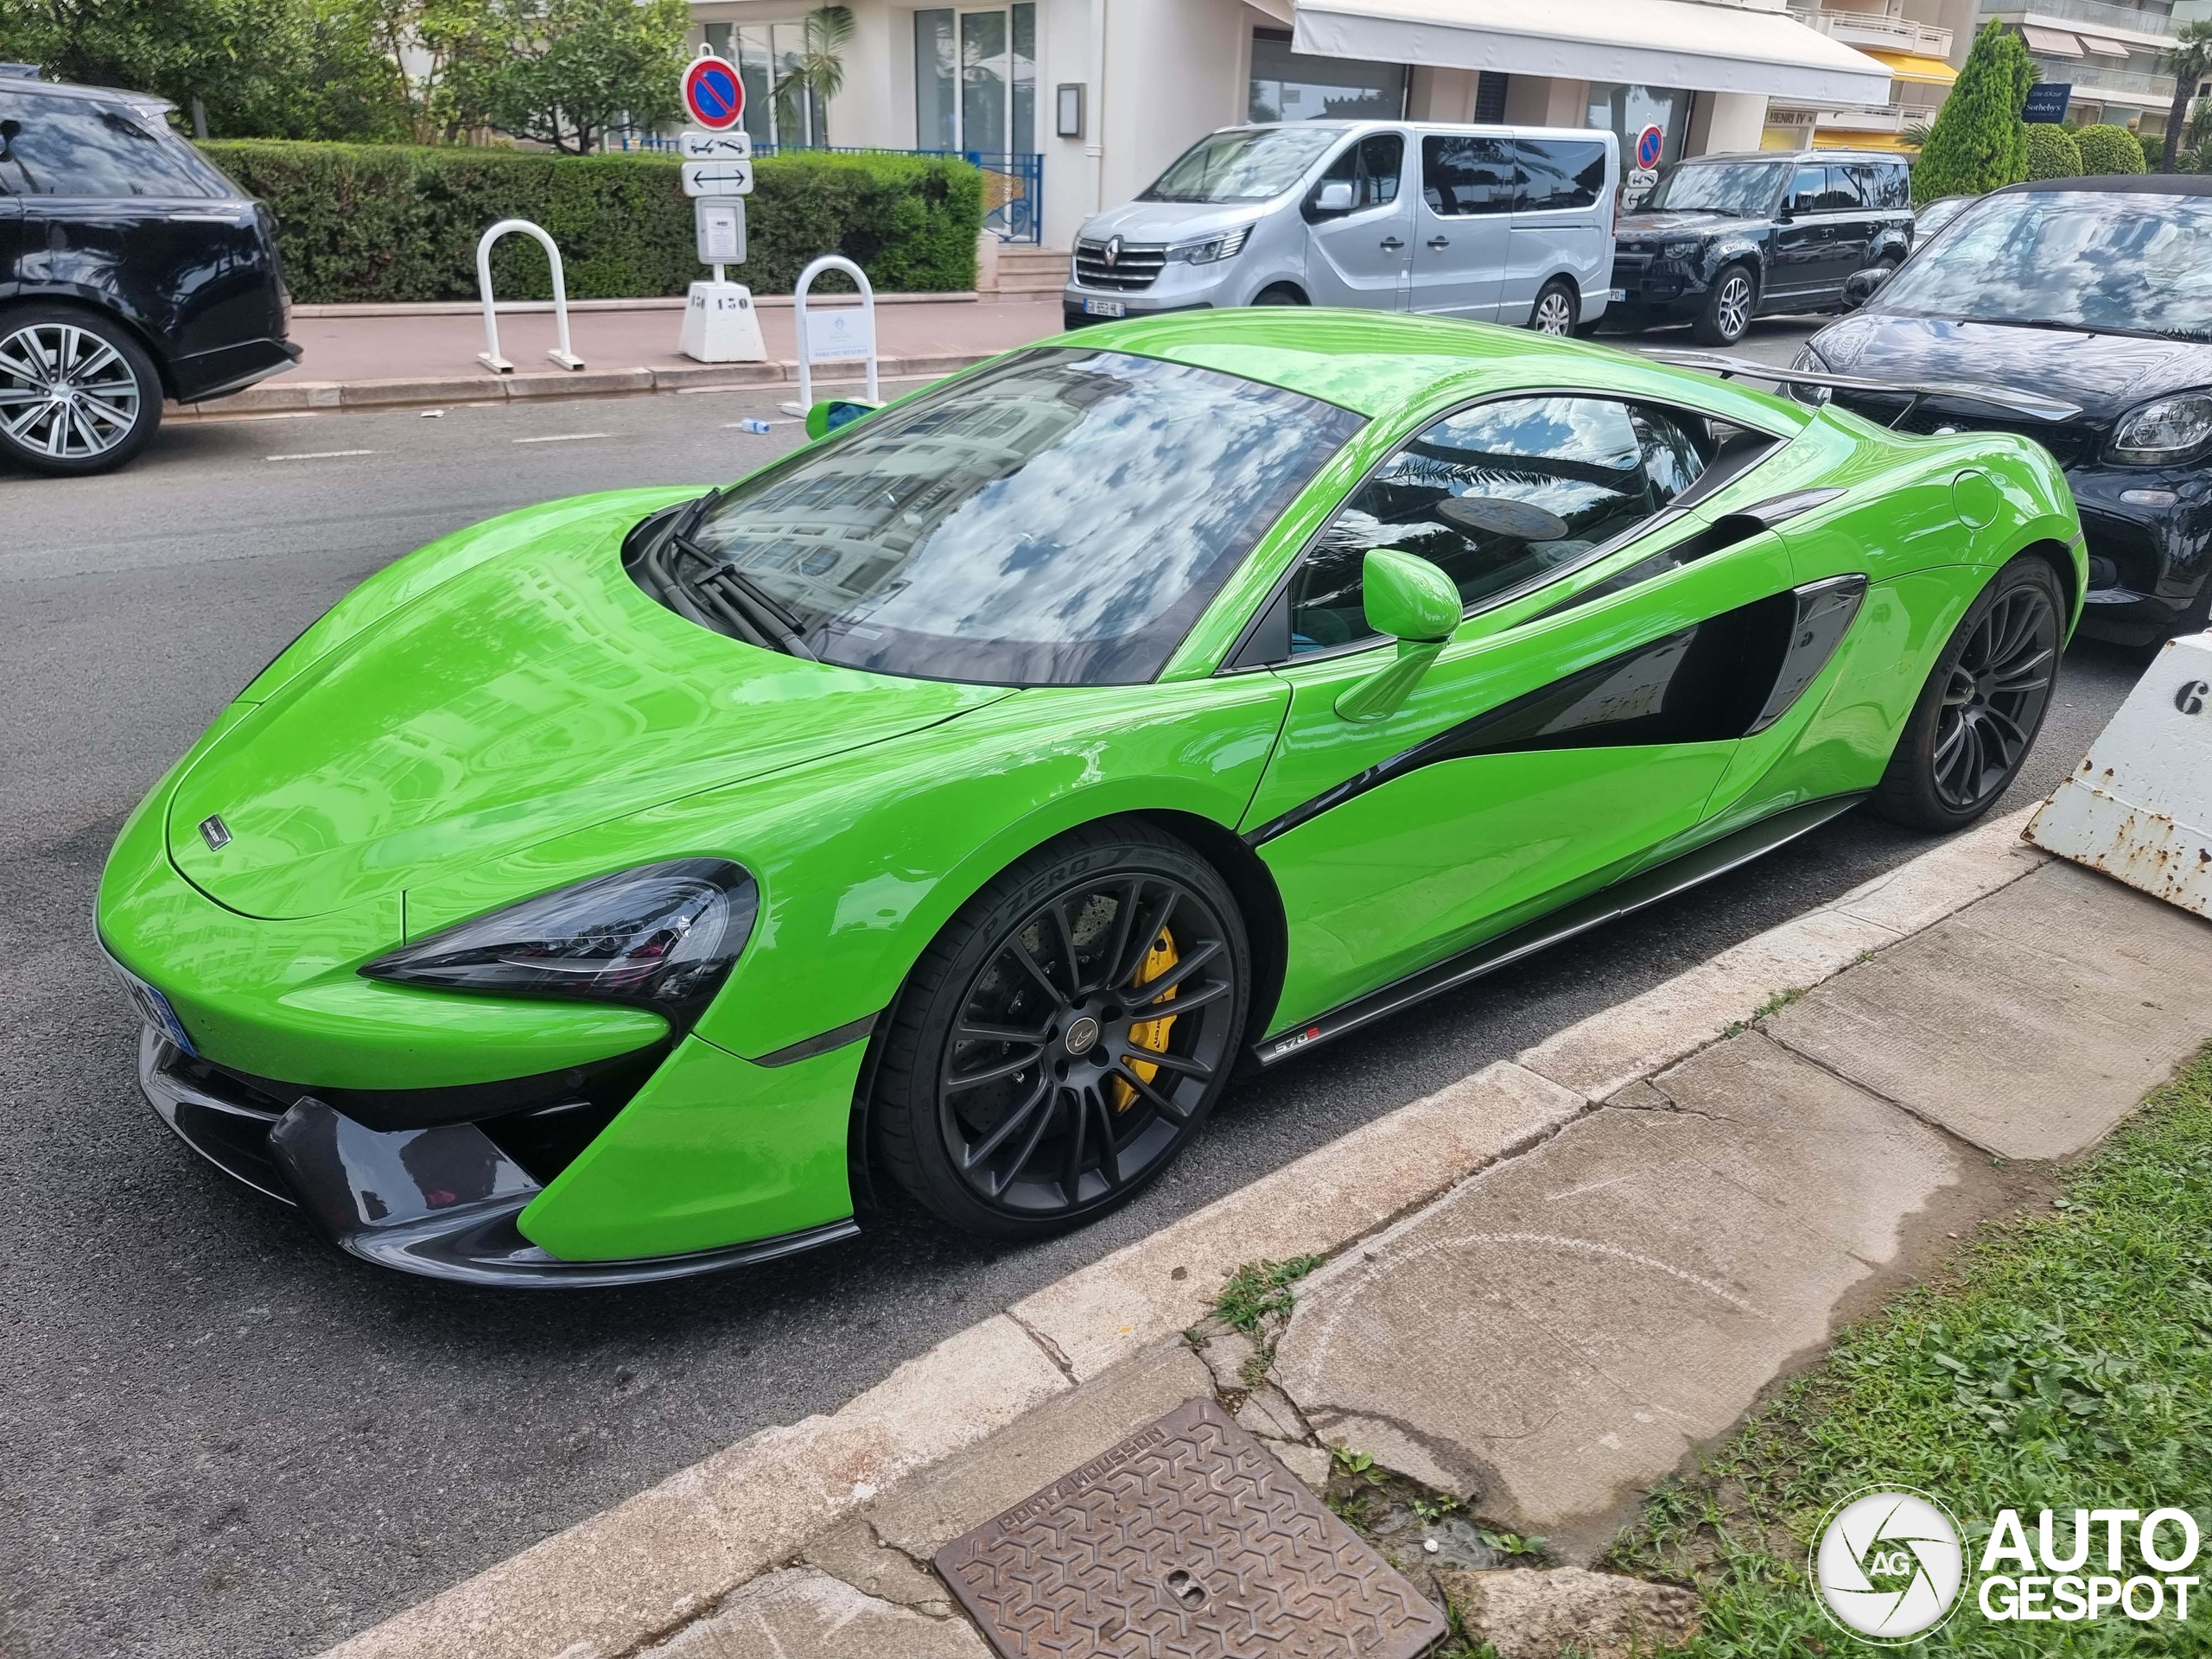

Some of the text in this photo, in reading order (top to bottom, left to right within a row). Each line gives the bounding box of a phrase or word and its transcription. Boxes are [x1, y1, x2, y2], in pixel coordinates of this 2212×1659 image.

[2175, 680, 2209, 715] 6
[1274, 1027, 1320, 1053] 570S
[998, 1427, 1166, 1532] PONT A MOUSSON
